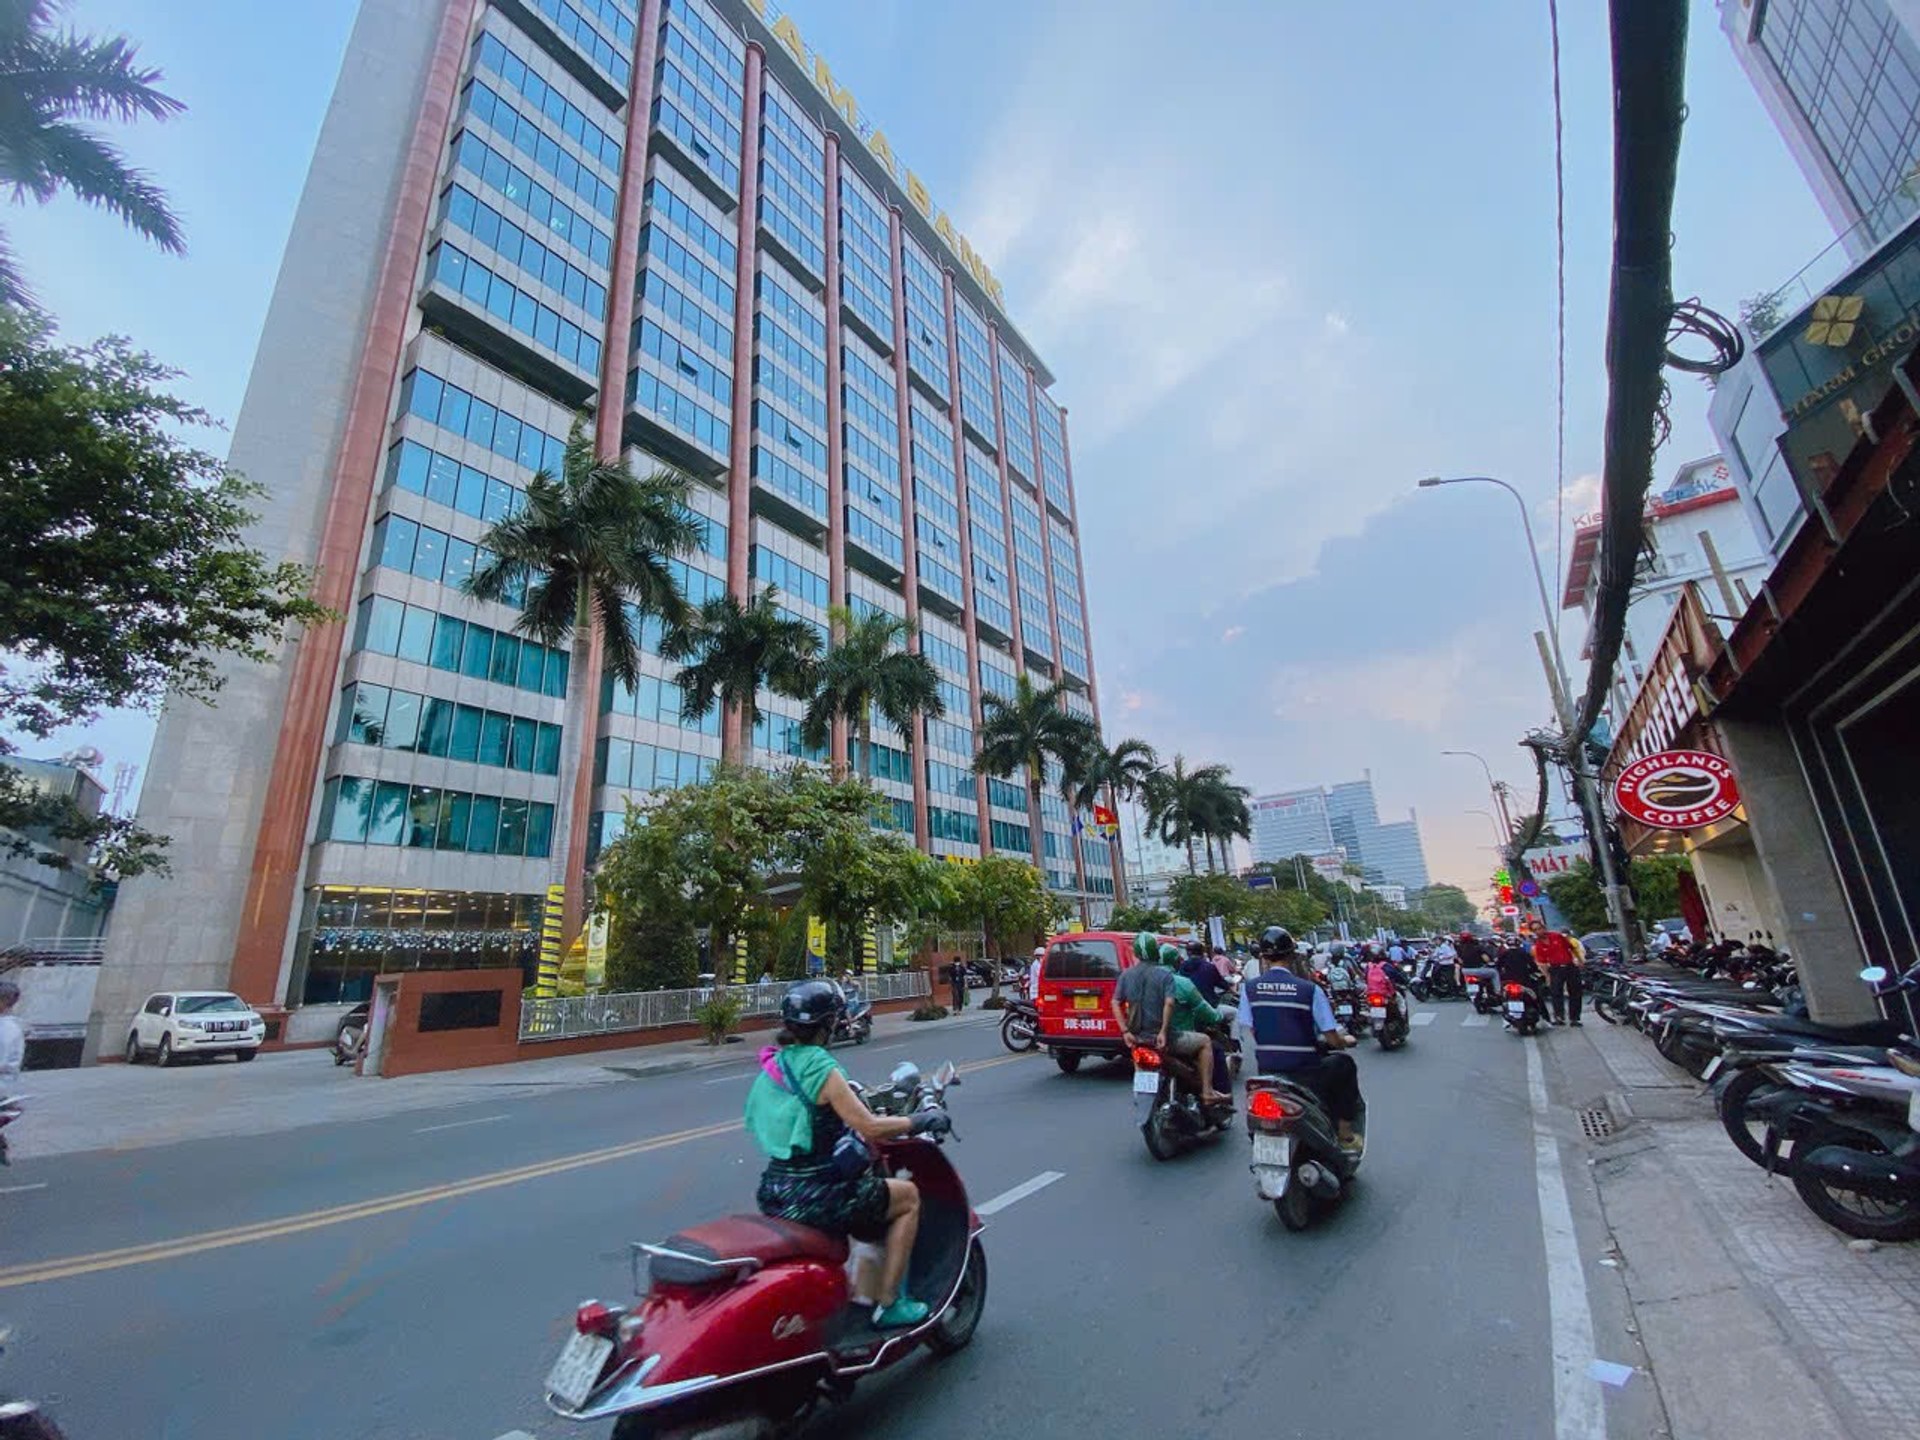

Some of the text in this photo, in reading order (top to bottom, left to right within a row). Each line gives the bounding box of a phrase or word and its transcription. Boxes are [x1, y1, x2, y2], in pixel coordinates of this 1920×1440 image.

[1620, 754, 1734, 793] HIGHLANDS
[1642, 798, 1731, 824] COFFEE
[1256, 982, 1297, 991] CENTRAL
